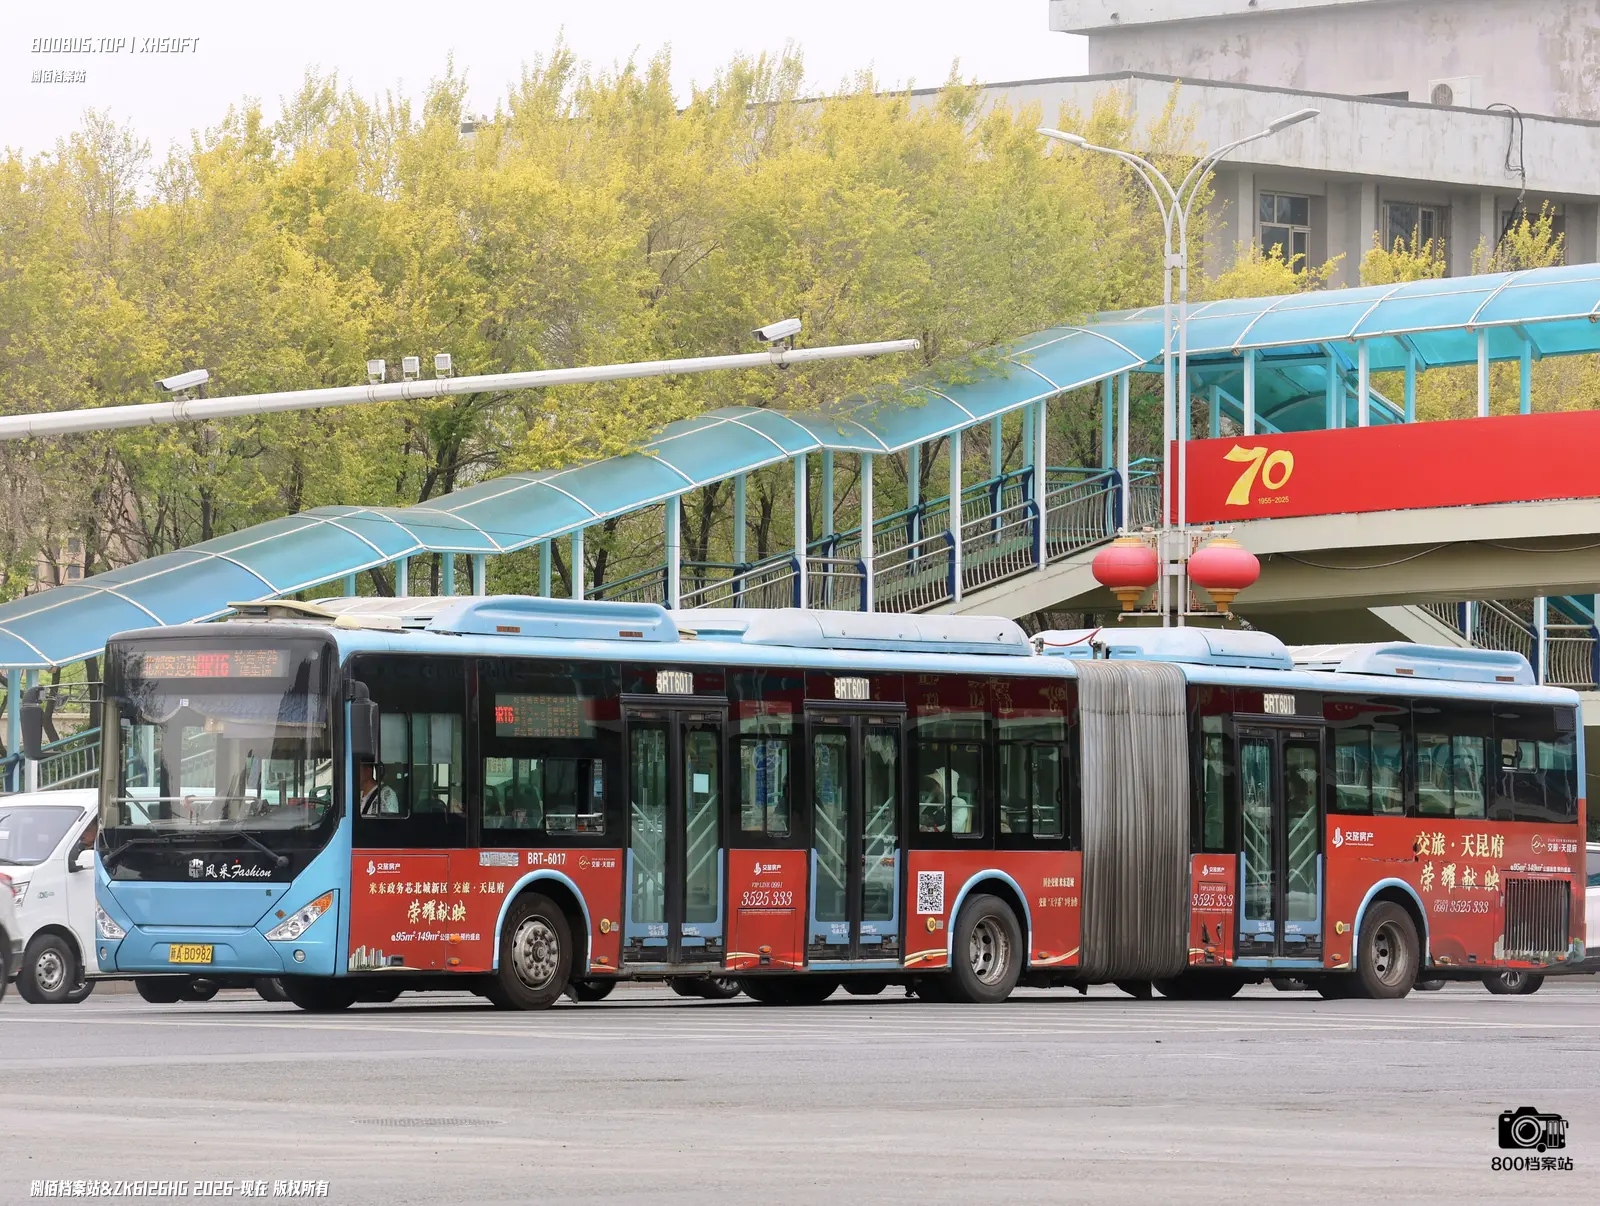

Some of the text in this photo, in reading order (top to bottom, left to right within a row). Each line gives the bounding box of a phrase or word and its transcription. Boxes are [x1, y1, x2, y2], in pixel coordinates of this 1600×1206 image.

[1223, 444, 1294, 506] 70
[1258, 496, 1290, 504] 1955-2025
[656, 670, 694, 694] BRT6017
[834, 677, 870, 699] BRT6017
[1263, 693, 1296, 714] BRT6017
[527, 852, 566, 865] BRT-6017
[205, 863, 272, 879] 风采 Fashion
[741, 890, 793, 906] 3525 333
[1192, 893, 1215, 907] 3525
[1449, 900, 1472, 913] 3525
[1472, 900, 1489, 913] 333
